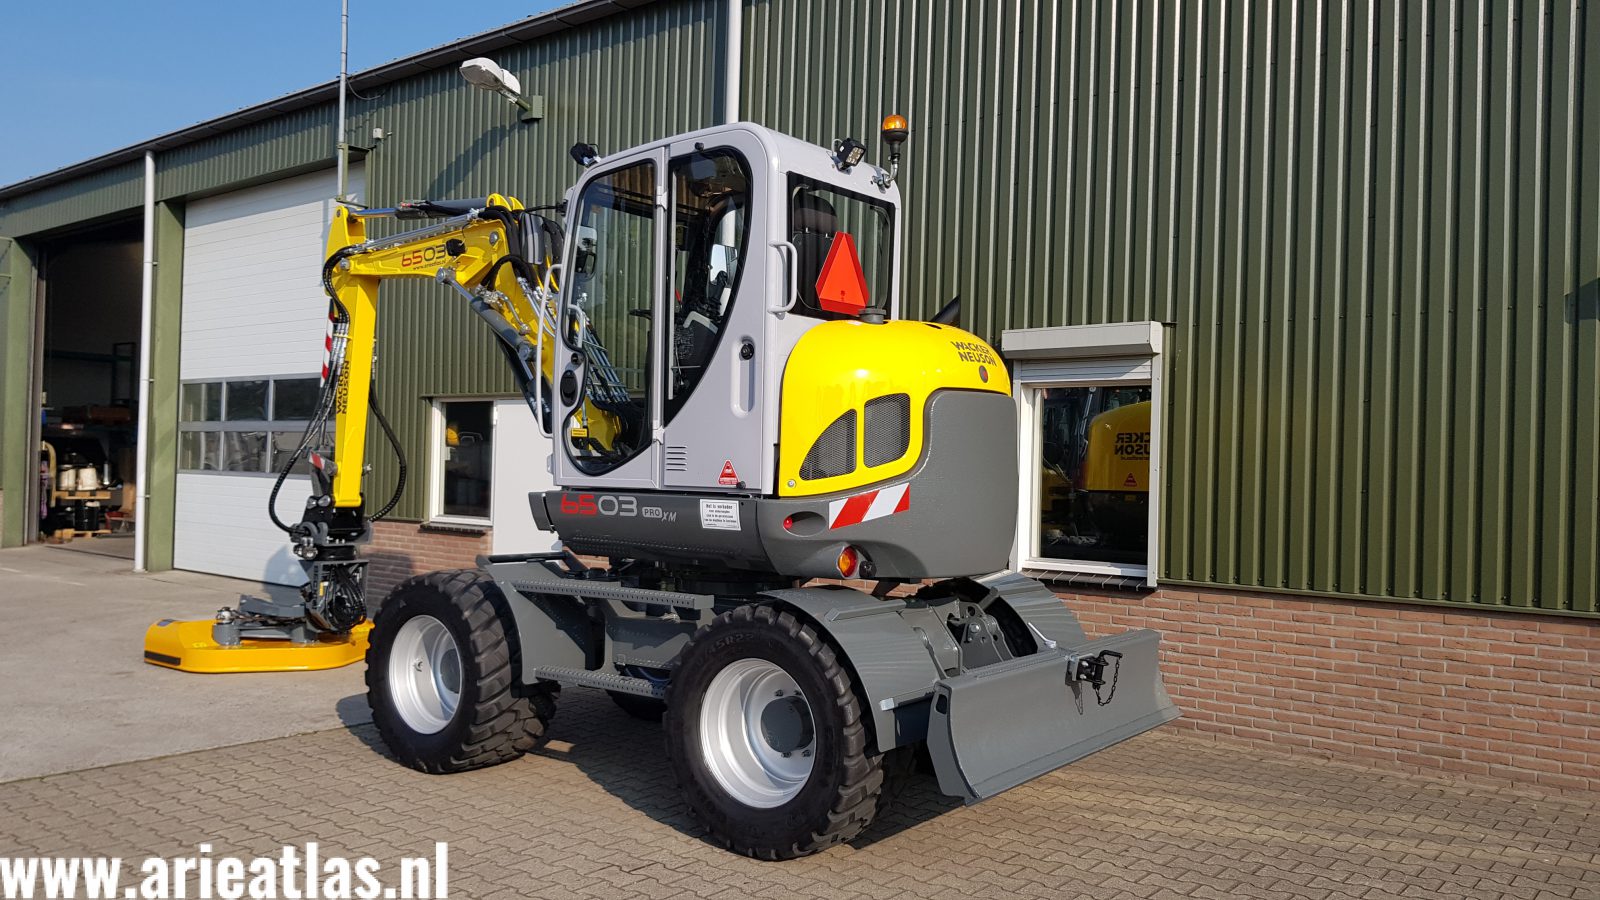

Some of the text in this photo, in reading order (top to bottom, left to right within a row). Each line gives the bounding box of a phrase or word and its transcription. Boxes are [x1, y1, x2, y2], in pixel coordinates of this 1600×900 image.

[402, 244, 446, 267] 6503
[950, 341, 992, 356] WACKER
[957, 351, 998, 367] NEUSON
[341, 360, 350, 415] NEUSON
[560, 493, 638, 517] 6503
